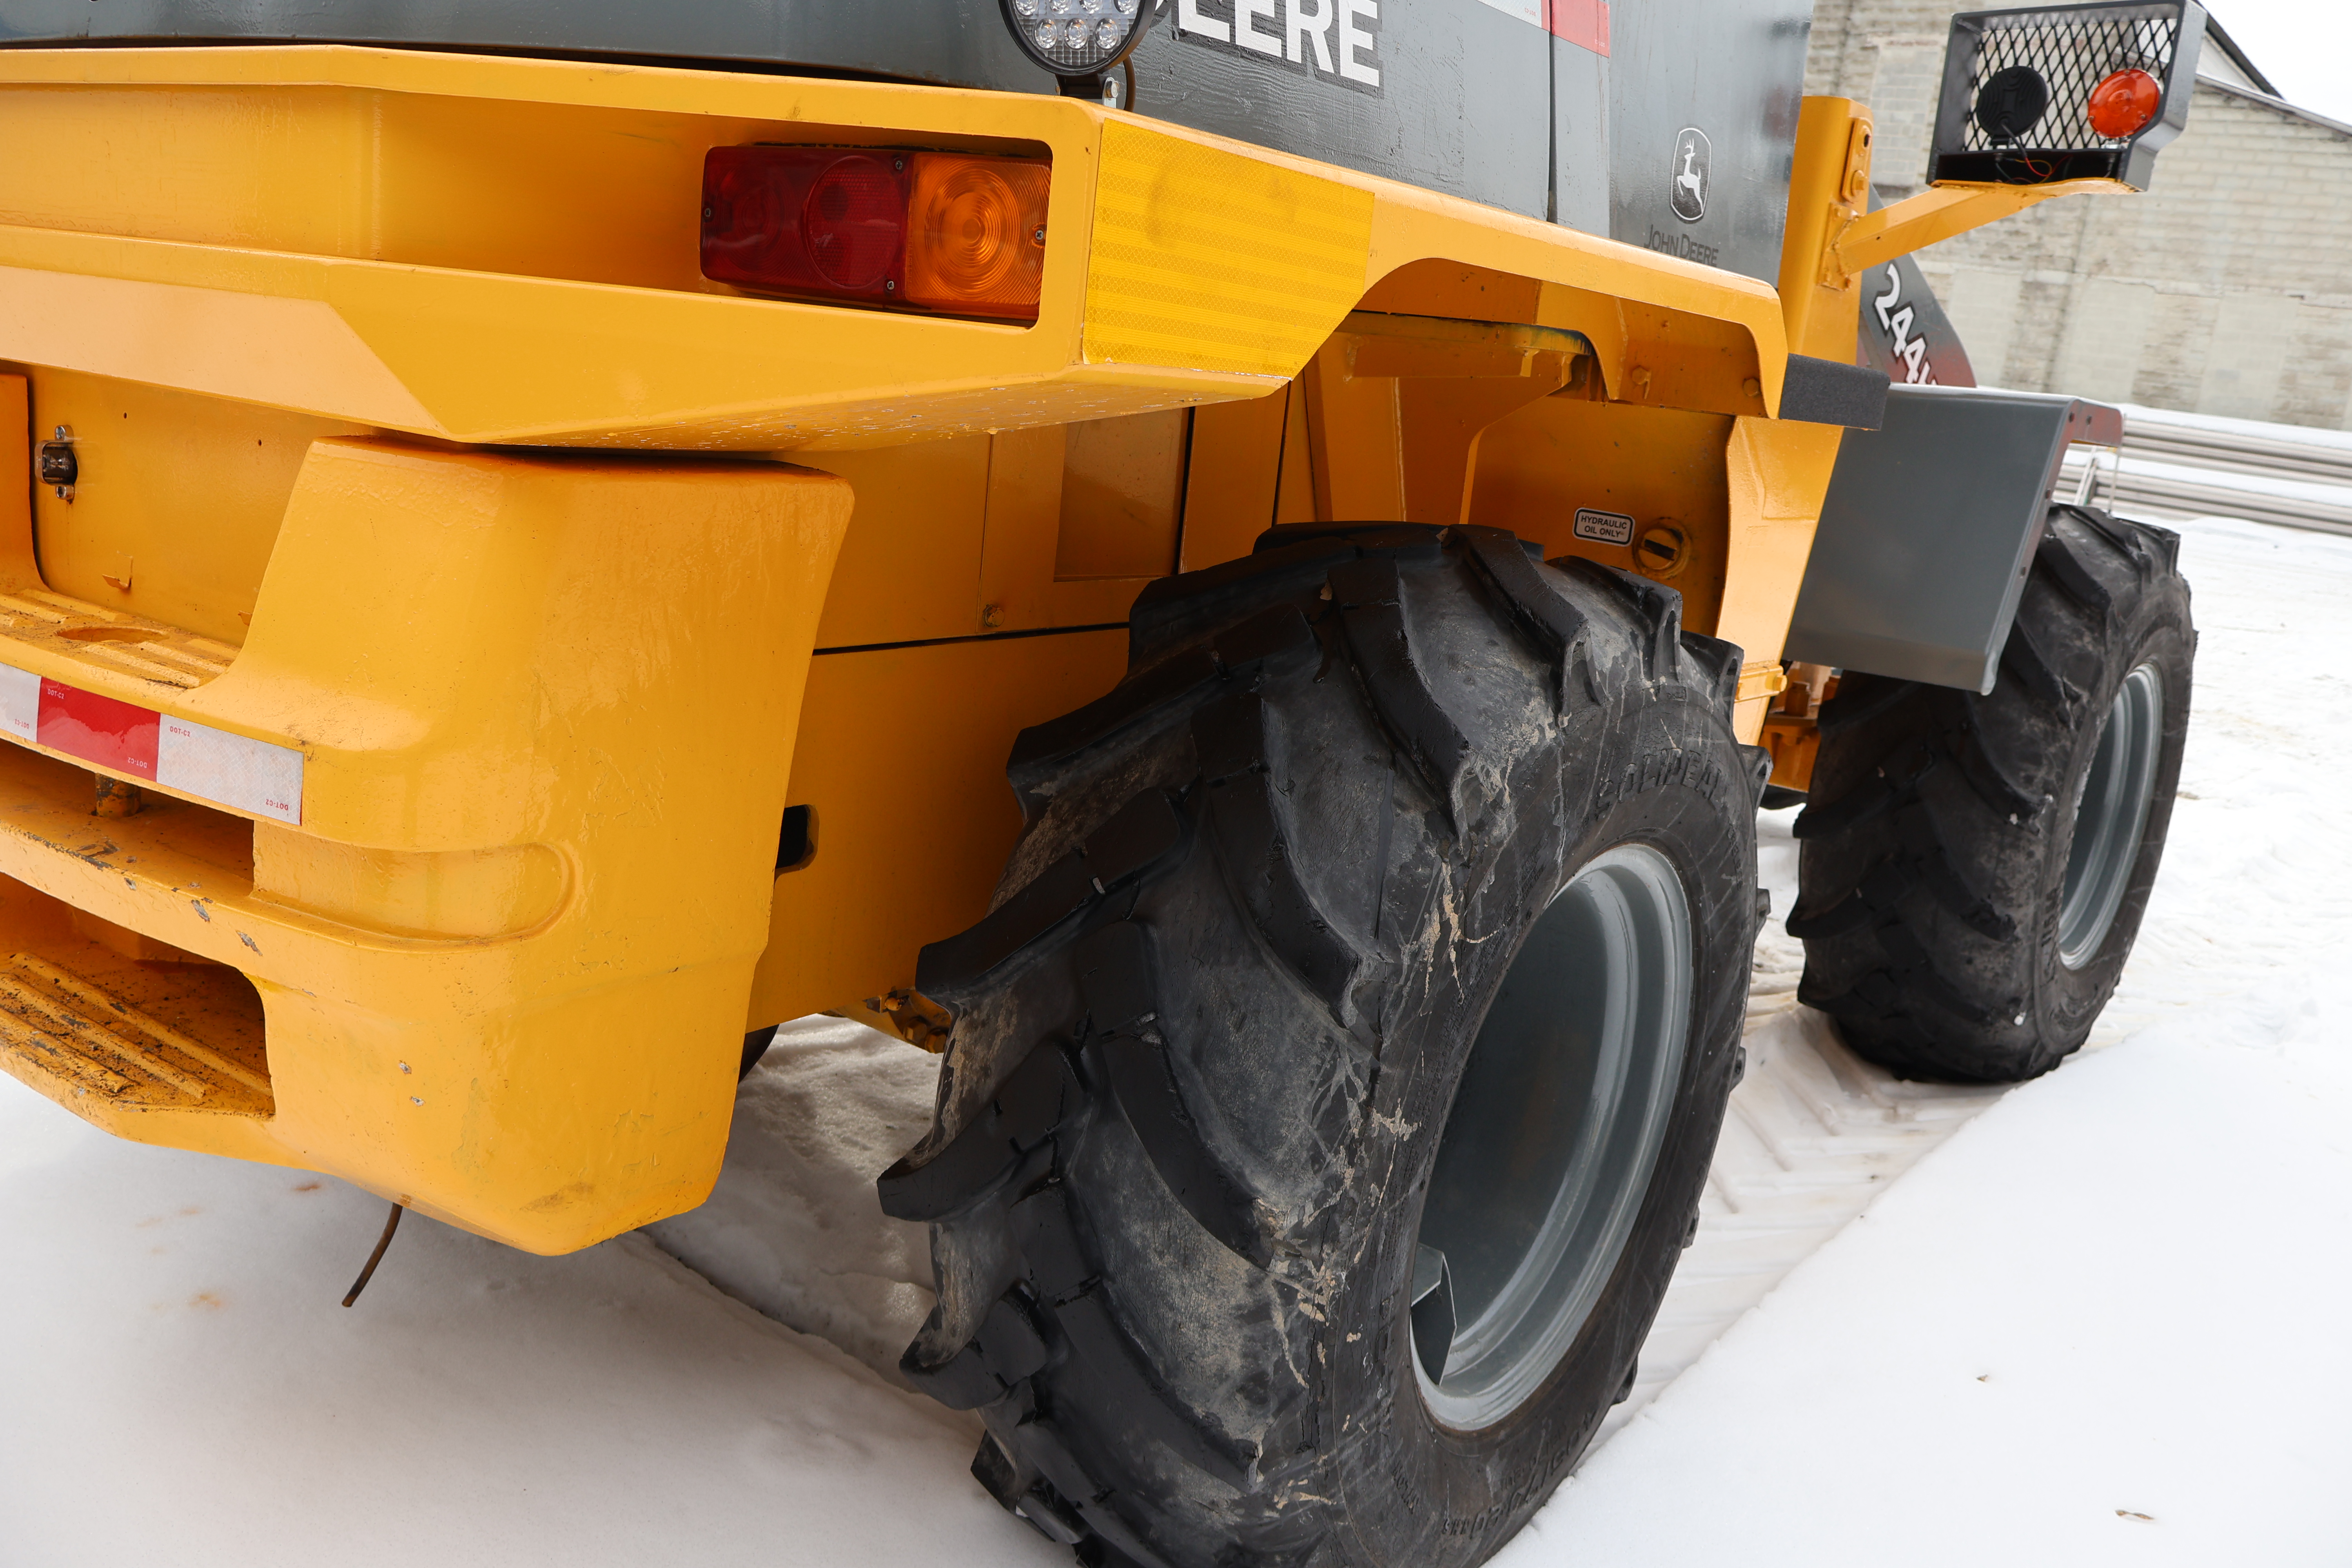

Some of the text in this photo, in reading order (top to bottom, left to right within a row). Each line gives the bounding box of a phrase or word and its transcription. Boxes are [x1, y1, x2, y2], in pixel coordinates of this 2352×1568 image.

[1156, 0, 1379, 87] ERE
[1644, 224, 1719, 267] JOHN DEERE
[1581, 515, 1626, 529] HYDRAULIC
[1600, 528, 1621, 537] ONLY
[47, 688, 64, 699] DOT-C2
[15, 719, 29, 729] DOT-C2
[170, 726, 191, 737] DOT-C2
[128, 757, 147, 768] DOT-C2
[266, 799, 289, 811] DOT-C2
